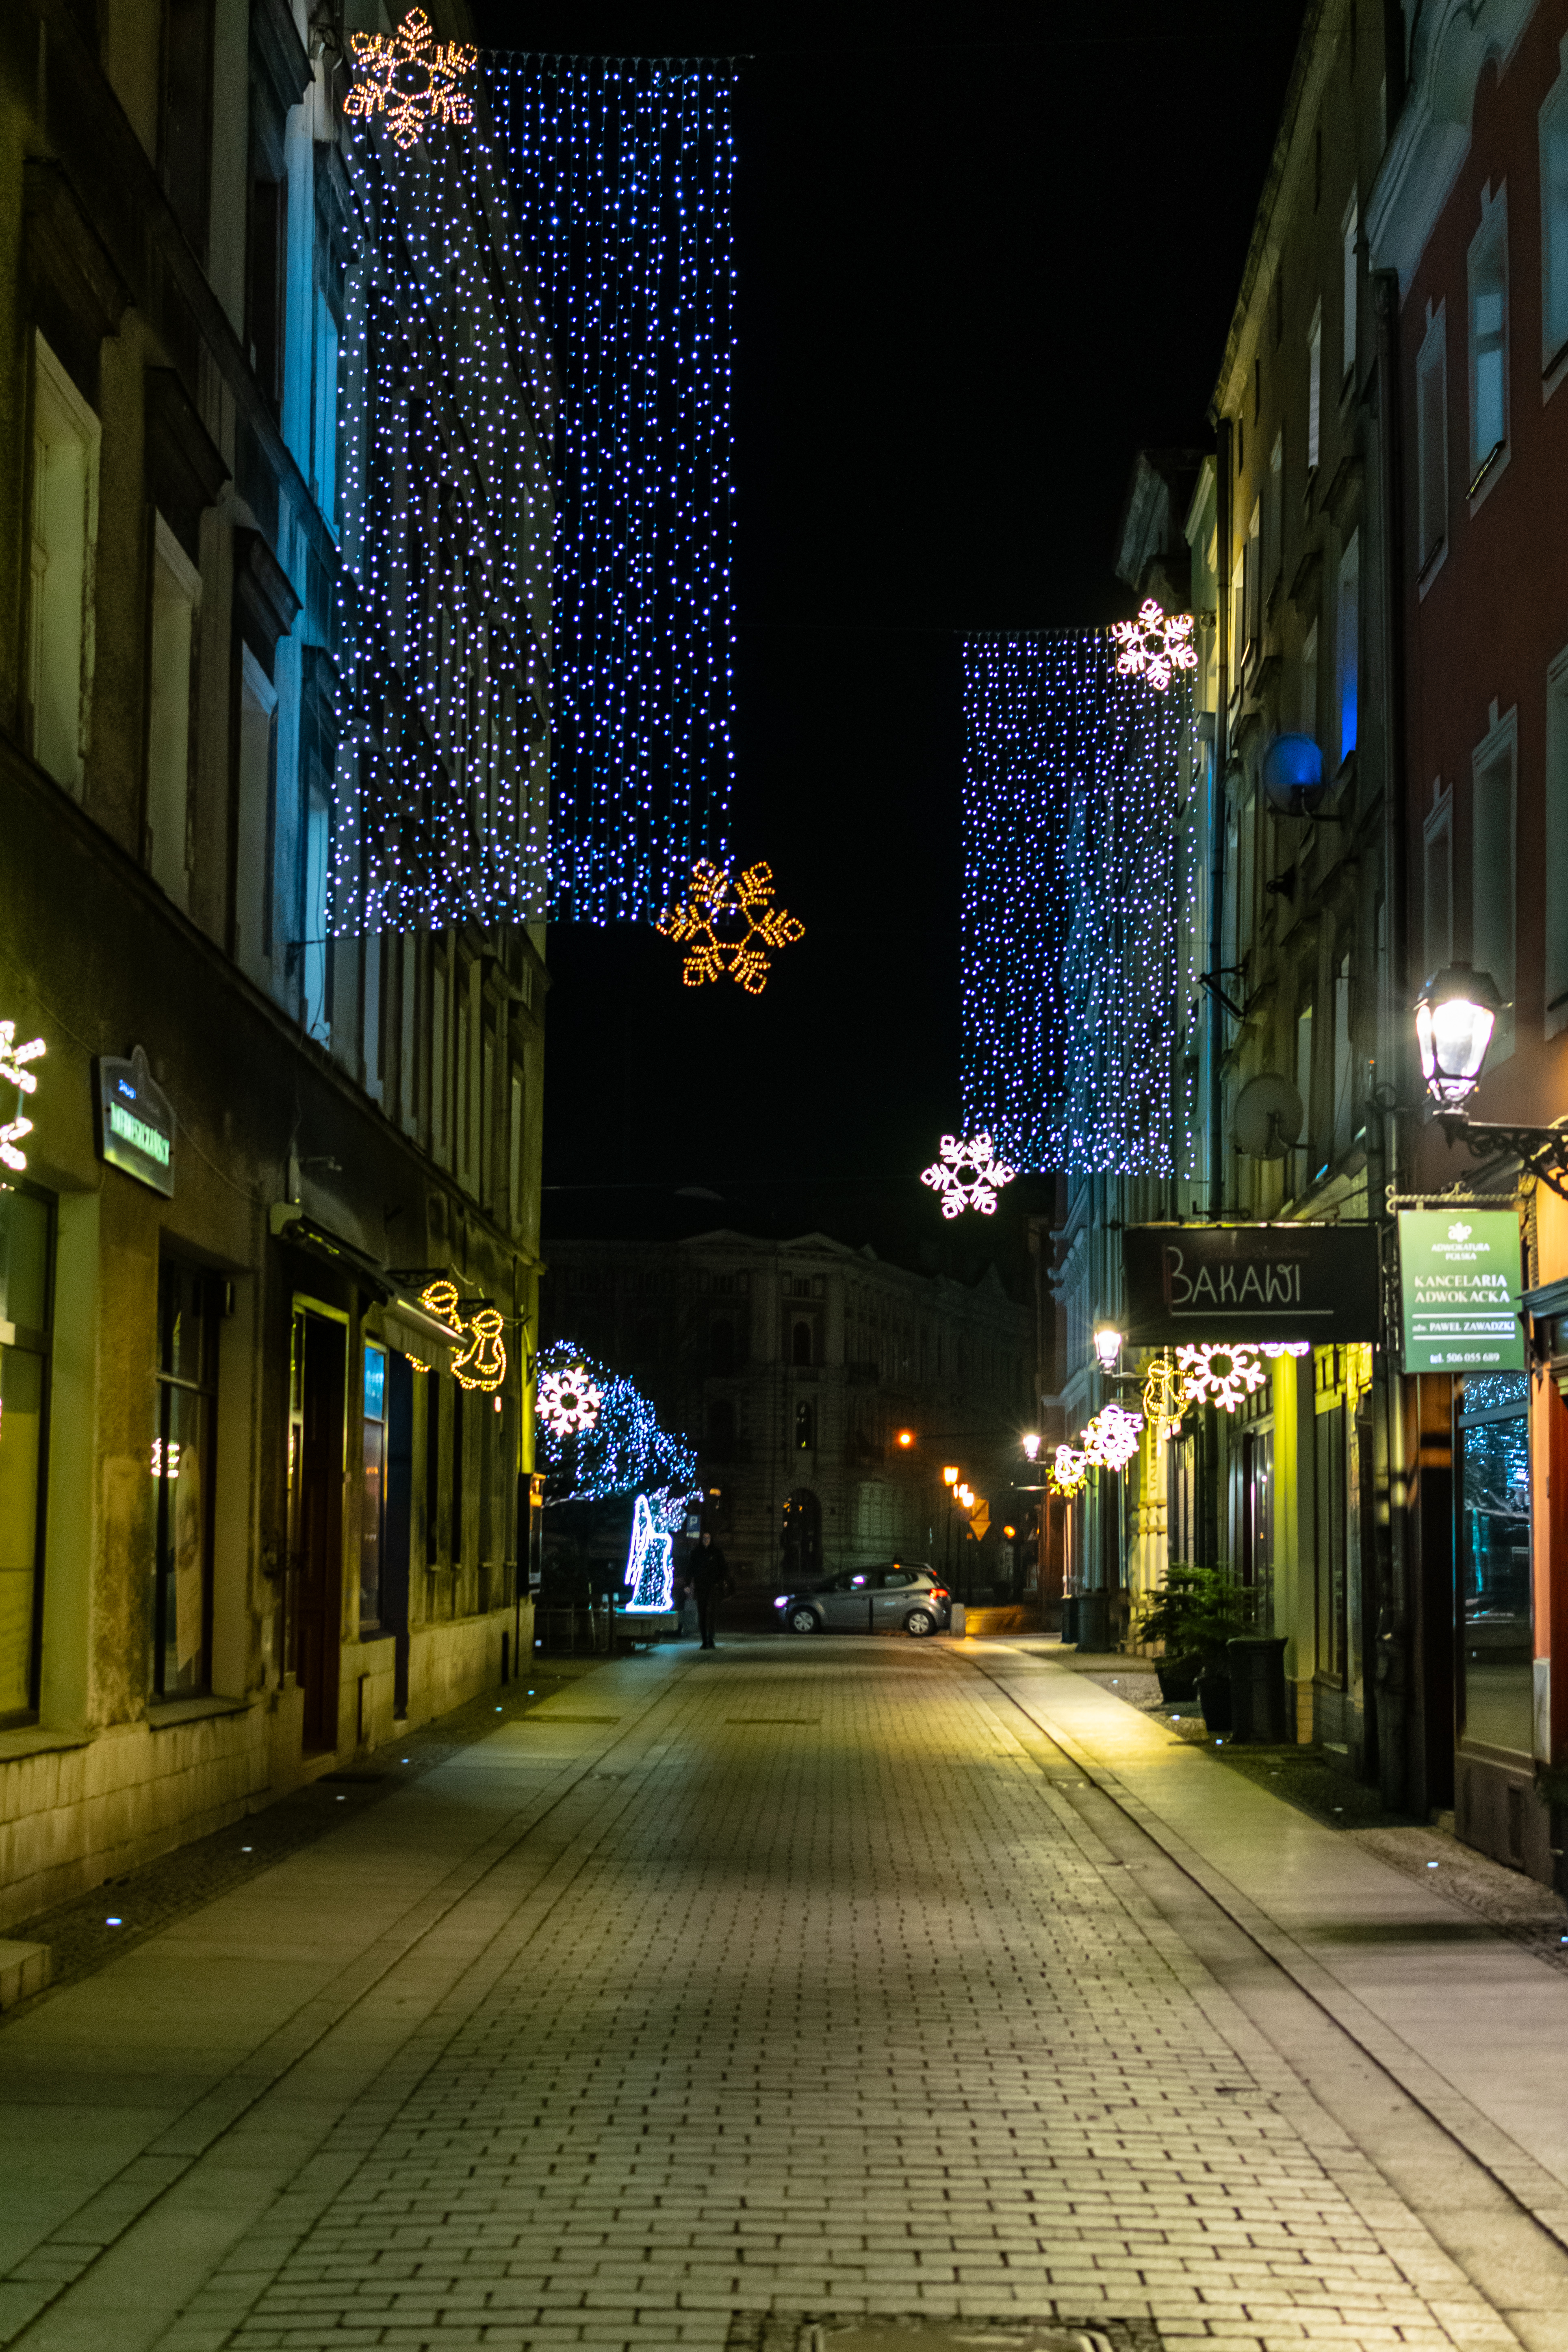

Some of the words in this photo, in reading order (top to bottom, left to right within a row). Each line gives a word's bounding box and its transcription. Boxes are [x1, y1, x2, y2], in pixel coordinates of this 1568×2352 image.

[1431, 1243, 1490, 1252] ADWOKATURA
[1445, 1252, 1477, 1261] POLSKA
[1414, 1274, 1507, 1287] KANCELARIA
[1415, 1290, 1510, 1303] ADWOKACKA
[1464, 1321, 1515, 1331] ZAWADZKI
[1446, 1353, 1463, 1363] 506
